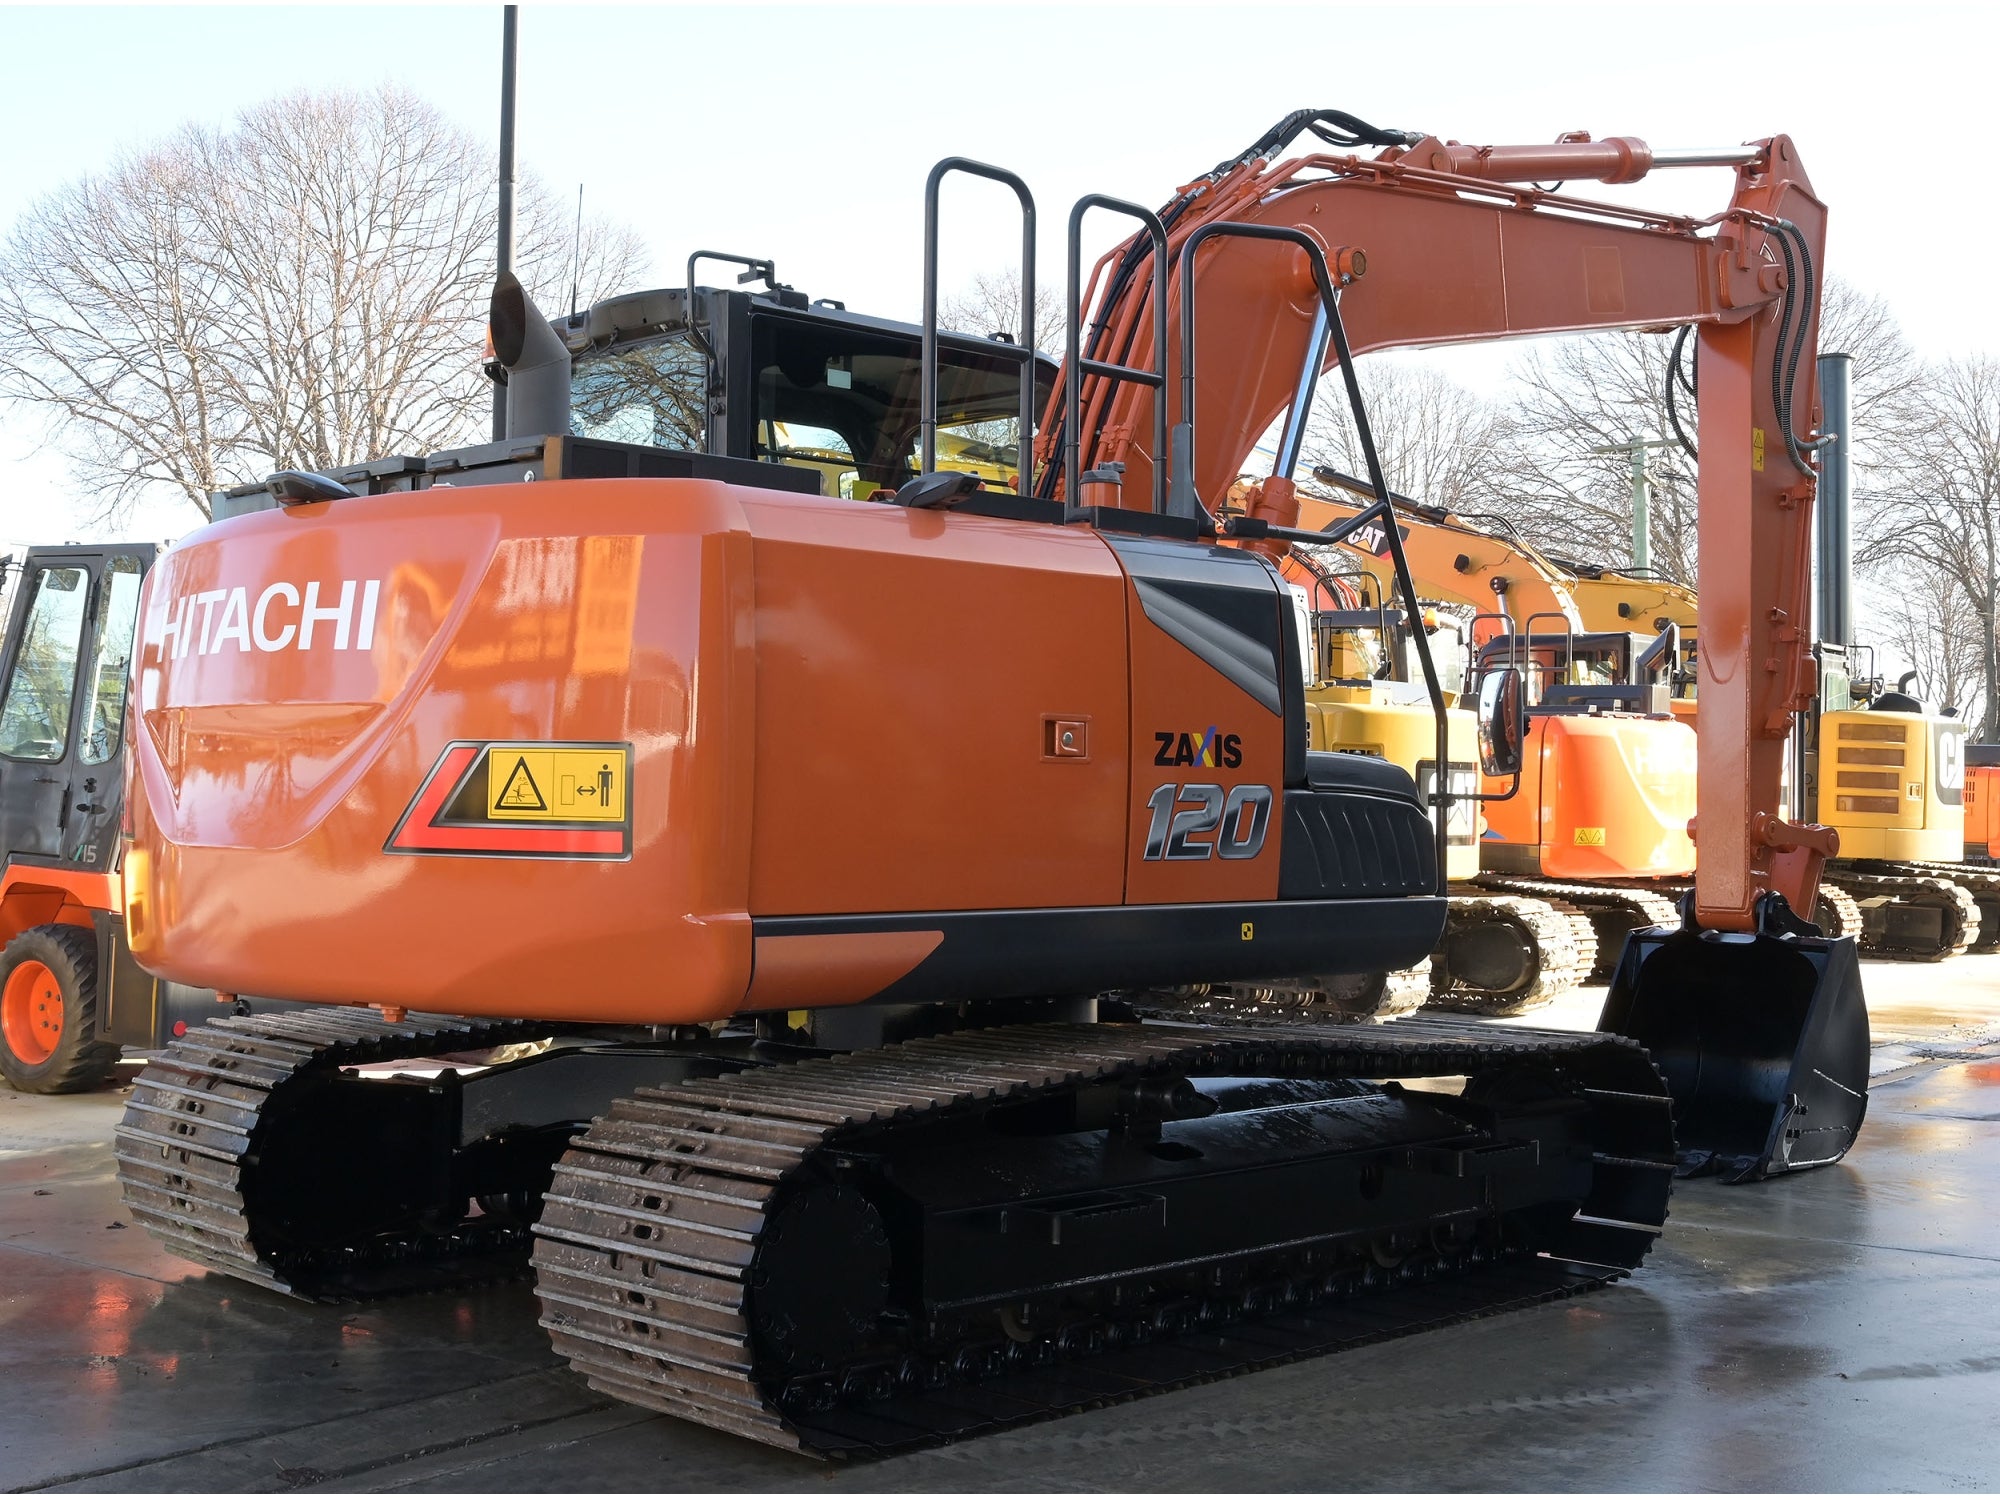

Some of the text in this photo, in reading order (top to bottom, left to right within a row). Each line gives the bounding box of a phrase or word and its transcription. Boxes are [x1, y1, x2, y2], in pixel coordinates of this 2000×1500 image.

[157, 580, 380, 662] HITACHI
[1155, 726, 1242, 768] ZAXIS
[1143, 784, 1273, 860] 120
